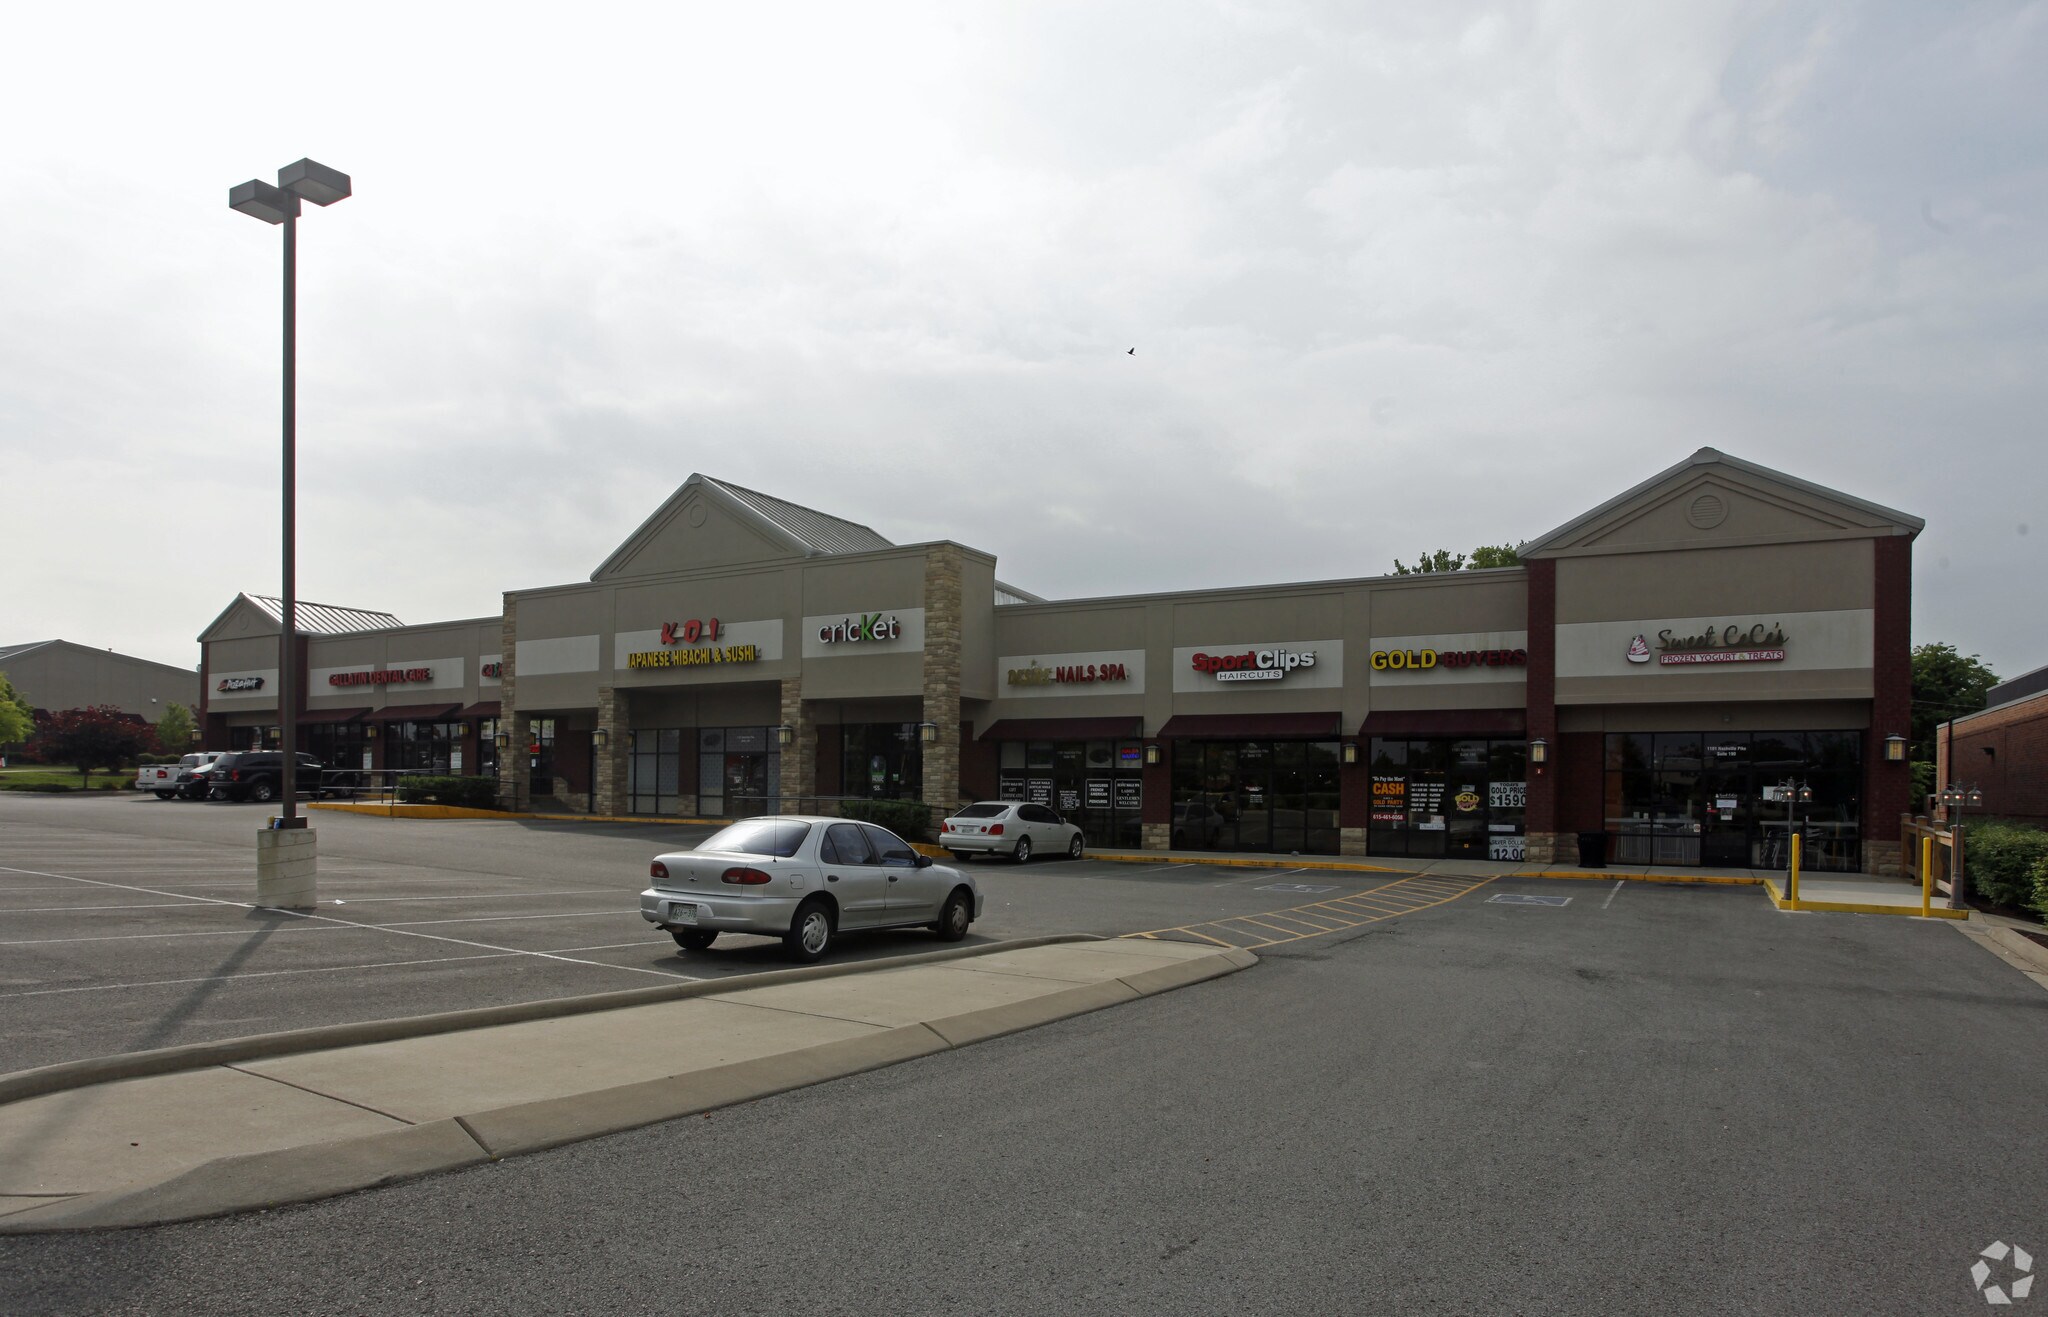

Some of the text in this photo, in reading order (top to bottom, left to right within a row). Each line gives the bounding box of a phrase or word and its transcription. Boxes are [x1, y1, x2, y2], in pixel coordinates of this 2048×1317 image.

[661, 617, 719, 644] KOI
[1655, 625, 1717, 650] Sweet
[627, 645, 755, 668] JAPANESE HIBACHI & SUSHI
[1371, 649, 1527, 670] GOLD BUYERS
[1662, 650, 1783, 664] FROZEN YOGURT & TREATS
[329, 668, 429, 687] GALLATIN DENTAL CARE
[1055, 665, 1096, 683] NAILS
[1099, 663, 1126, 681] SPA
[1219, 671, 1280, 680] HAIRCUTS
[1372, 783, 1405, 795] CASH
